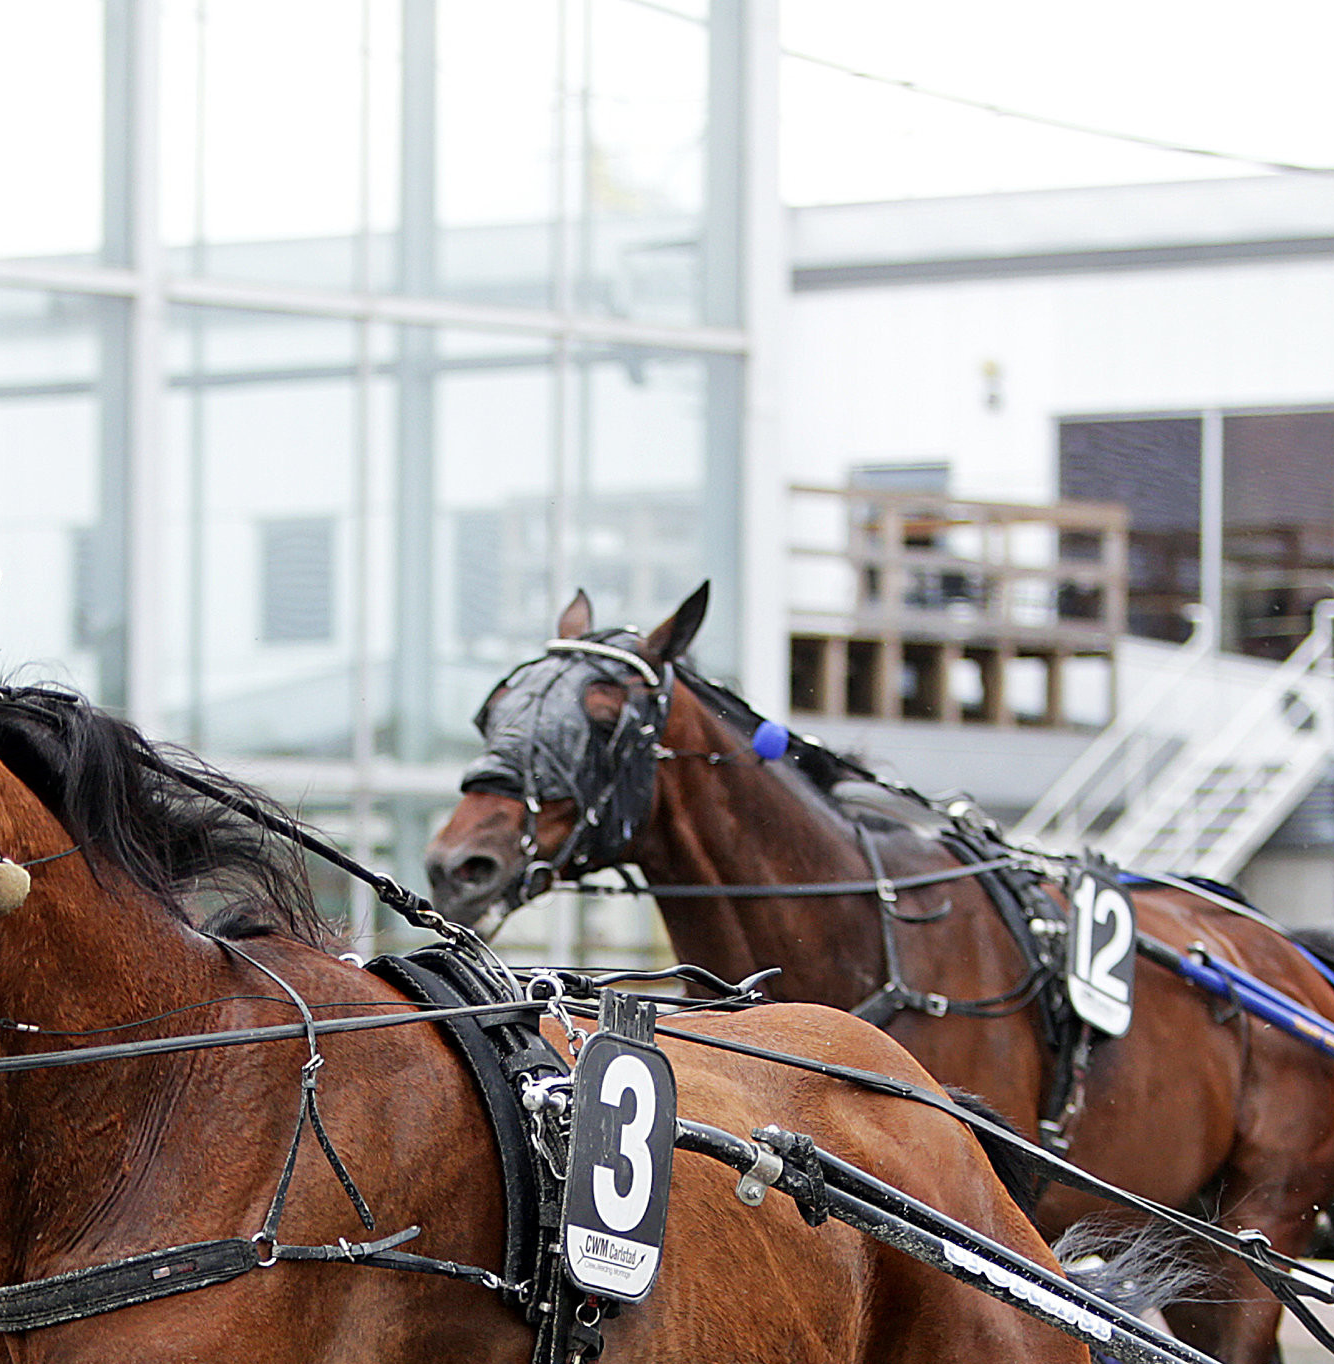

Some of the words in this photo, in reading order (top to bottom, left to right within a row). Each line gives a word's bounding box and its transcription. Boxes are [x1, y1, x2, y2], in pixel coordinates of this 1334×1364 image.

[1074, 873, 1133, 1002] 12
[593, 1055, 655, 1232] 3
[585, 1234, 609, 1257] CWM
[609, 1243, 637, 1265] Carlstad
